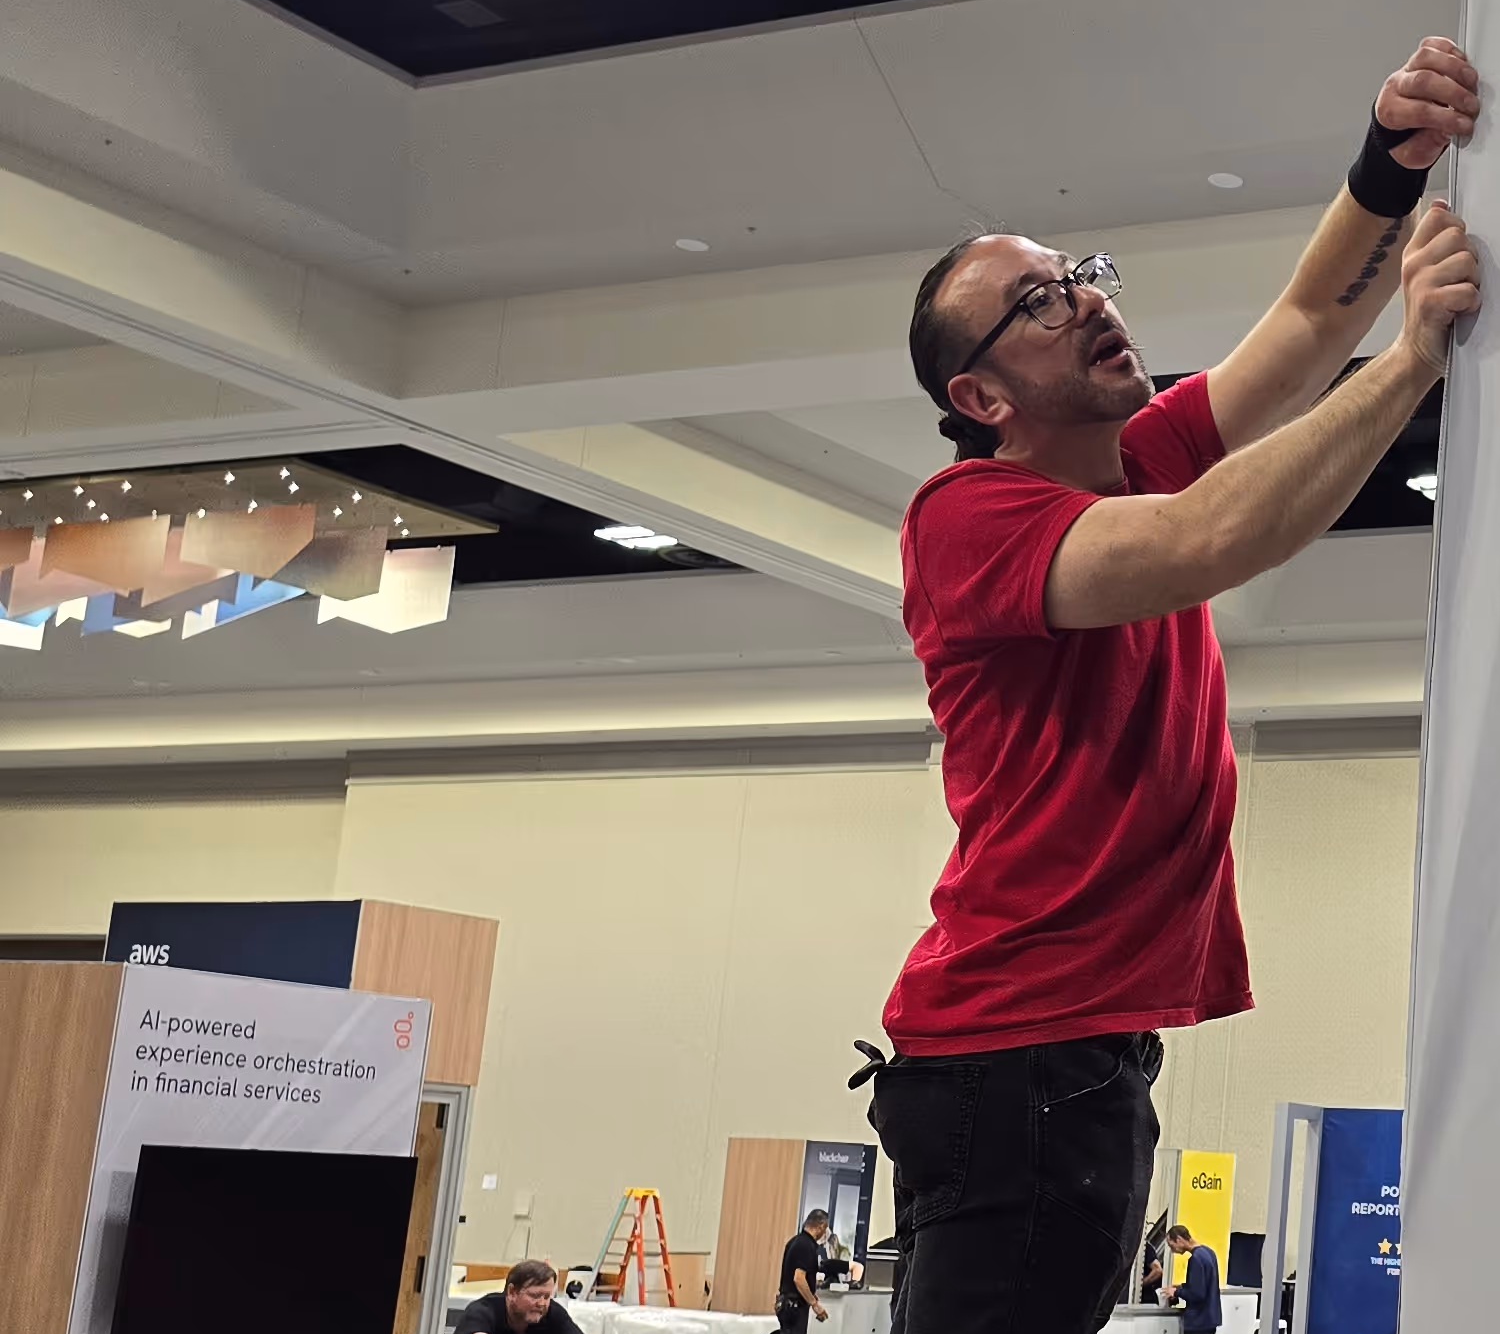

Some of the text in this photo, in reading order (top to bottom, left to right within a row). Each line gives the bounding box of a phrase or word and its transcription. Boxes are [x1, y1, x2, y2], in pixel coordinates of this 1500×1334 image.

[129, 943, 170, 964] aws
[139, 1009, 257, 1040] AI-powered
[135, 1043, 377, 1081] experience orchestration
[130, 1070, 322, 1104] in financial services
[1192, 1172, 1222, 1190] eGain
